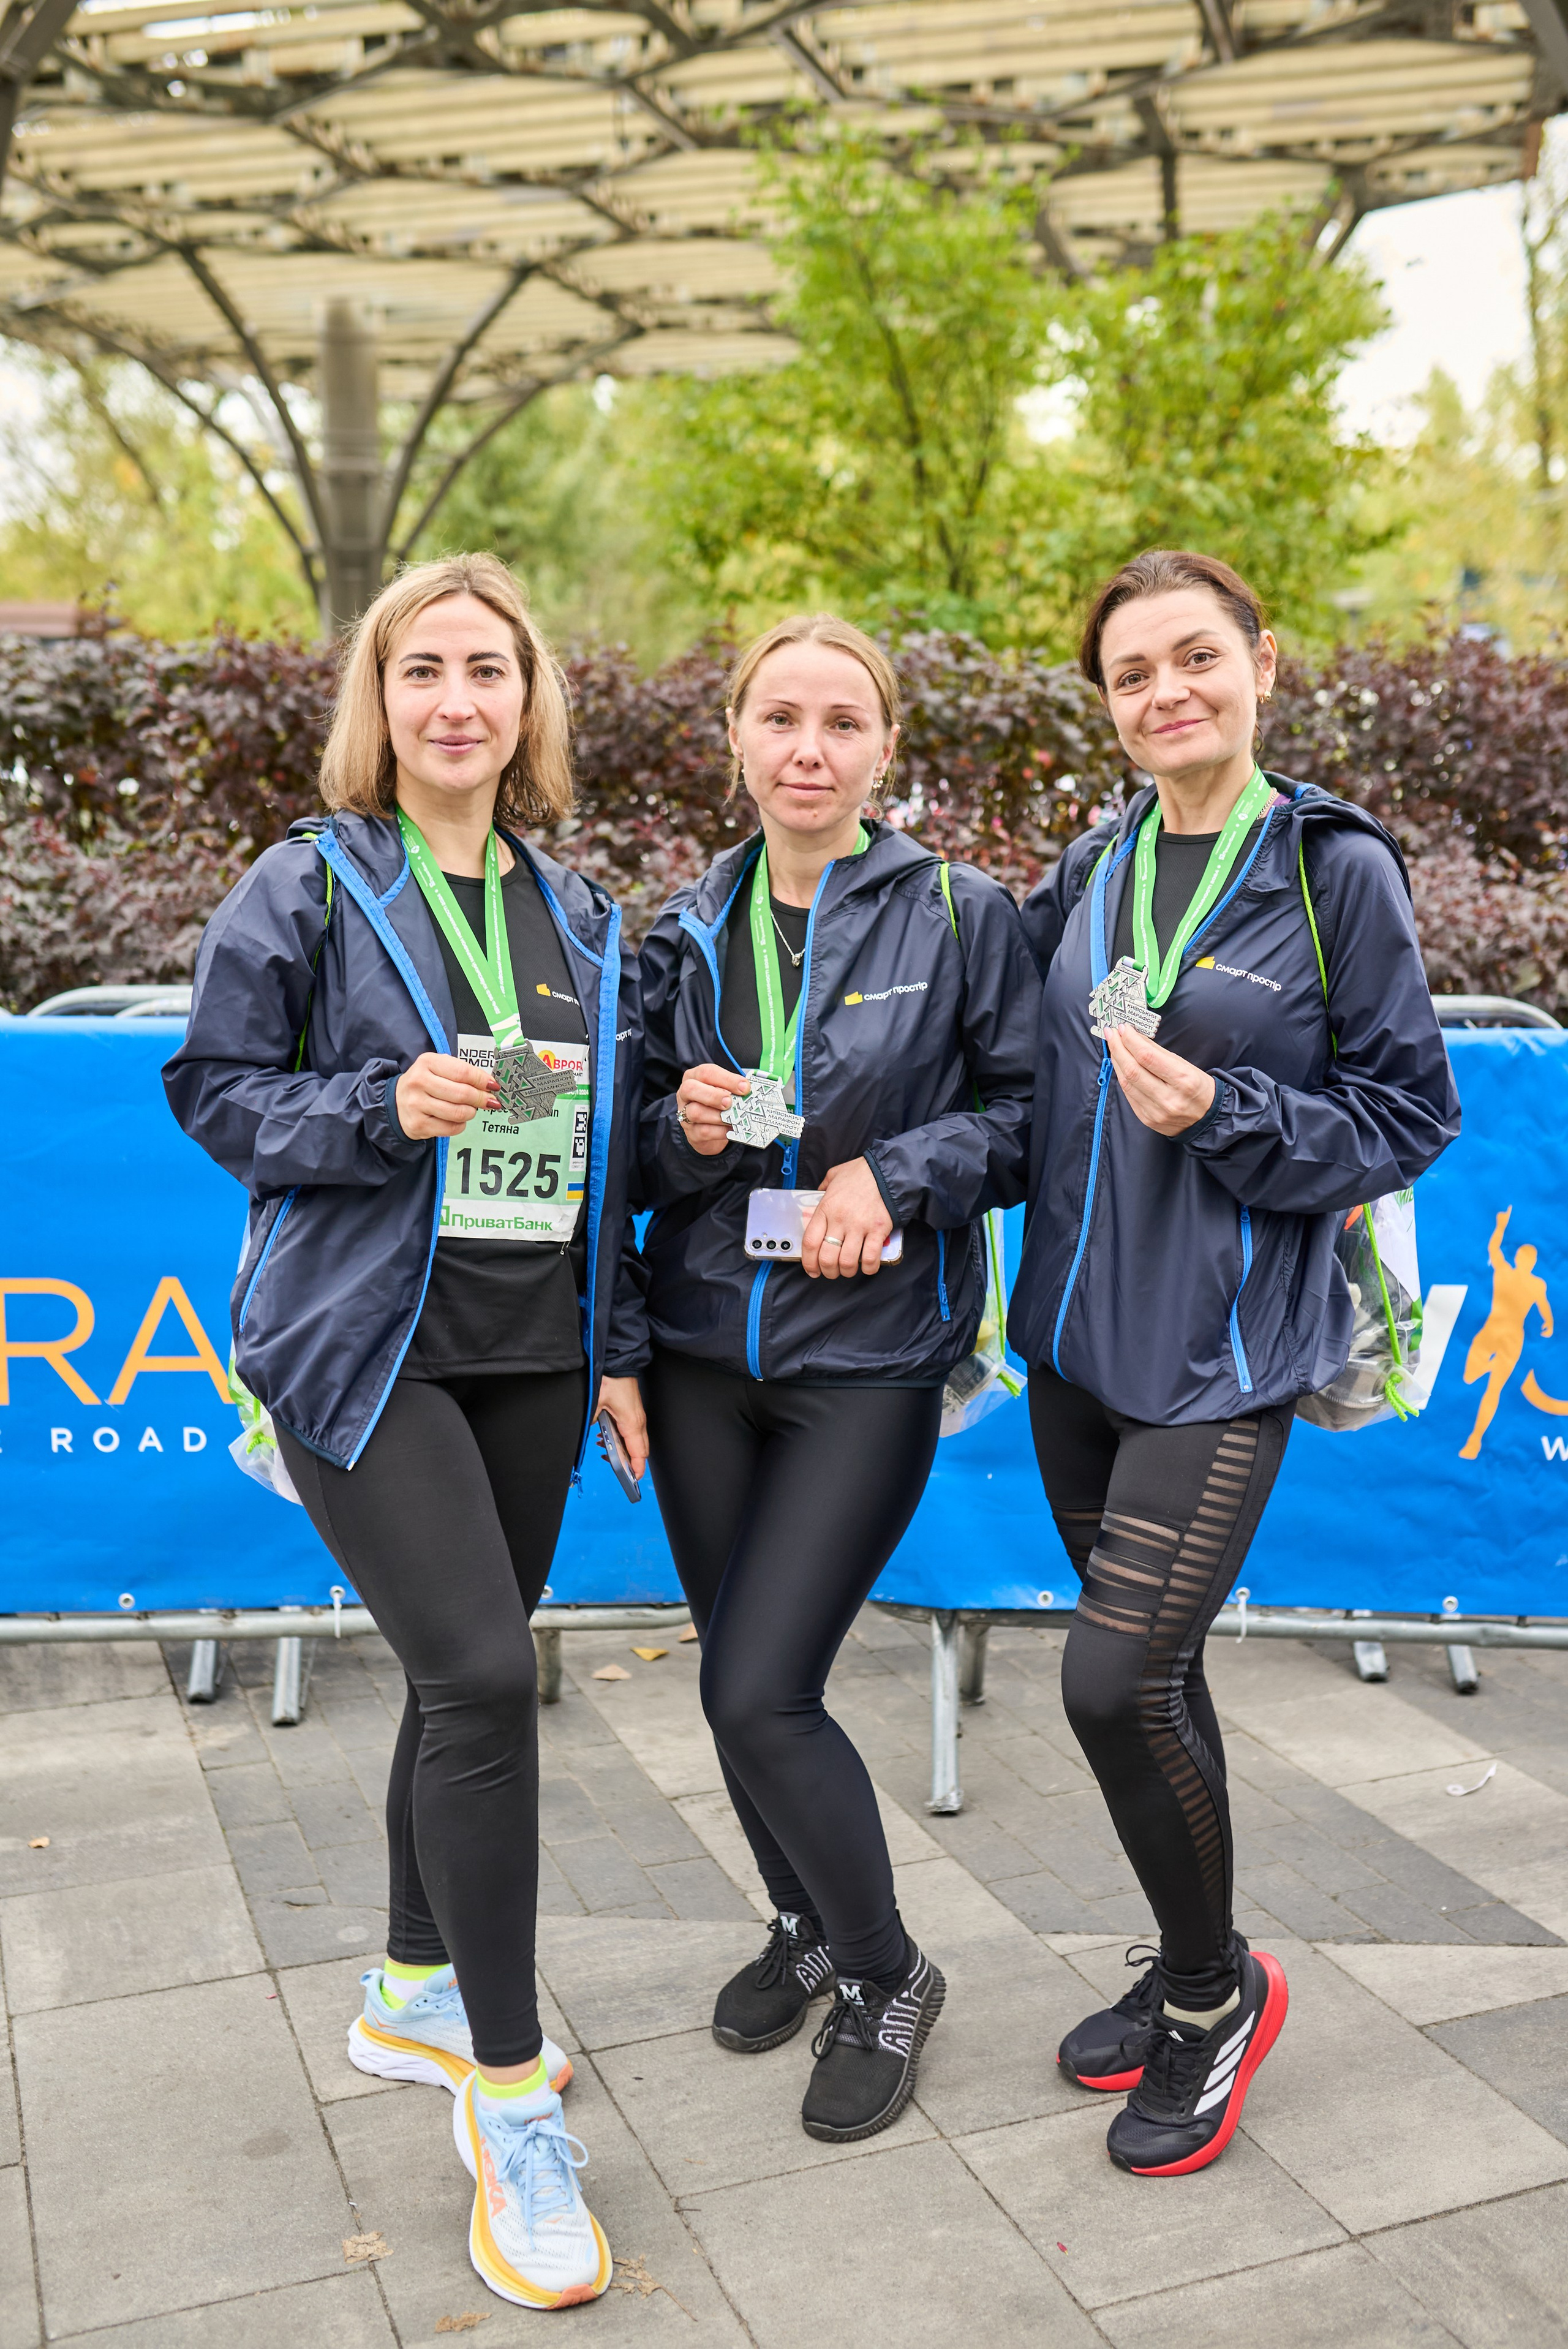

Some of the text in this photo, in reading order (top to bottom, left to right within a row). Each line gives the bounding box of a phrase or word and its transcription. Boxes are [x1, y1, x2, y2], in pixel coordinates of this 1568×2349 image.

[1216, 963, 1282, 992] смарт простір
[864, 981, 928, 1001] смарт простір
[1127, 1004, 1157, 1020] КИЇВСЬКИЙ
[1128, 1009, 1155, 1025] МАРАФОН
[1115, 1011, 1153, 1031] НЕЗЛАМНОСТІ
[616, 1028, 627, 1041] арт
[459, 1048, 495, 1060] NDER
[542, 1054, 583, 1071] АВРОР
[532, 1071, 570, 1082] КИЇВСЬКИЙ
[537, 1076, 571, 1087] МАРАФОН
[524, 1082, 573, 1095] НЕЗЛАМНОСТІ
[766, 1108, 802, 1122] КИЇВСЬКИЙ
[767, 1114, 801, 1126] МАРАФОН
[482, 1120, 519, 1134] Тетяна
[754, 1117, 799, 1131] НЕЗЛАМНОСТІ
[457, 1147, 561, 1199] 1525
[451, 1213, 553, 1231] ПриватБанк
[50, 1427, 207, 1453] ROAD
[780, 1915, 798, 1936] M
[839, 1984, 863, 2000] M
[480, 2135, 507, 2219] HOKA
